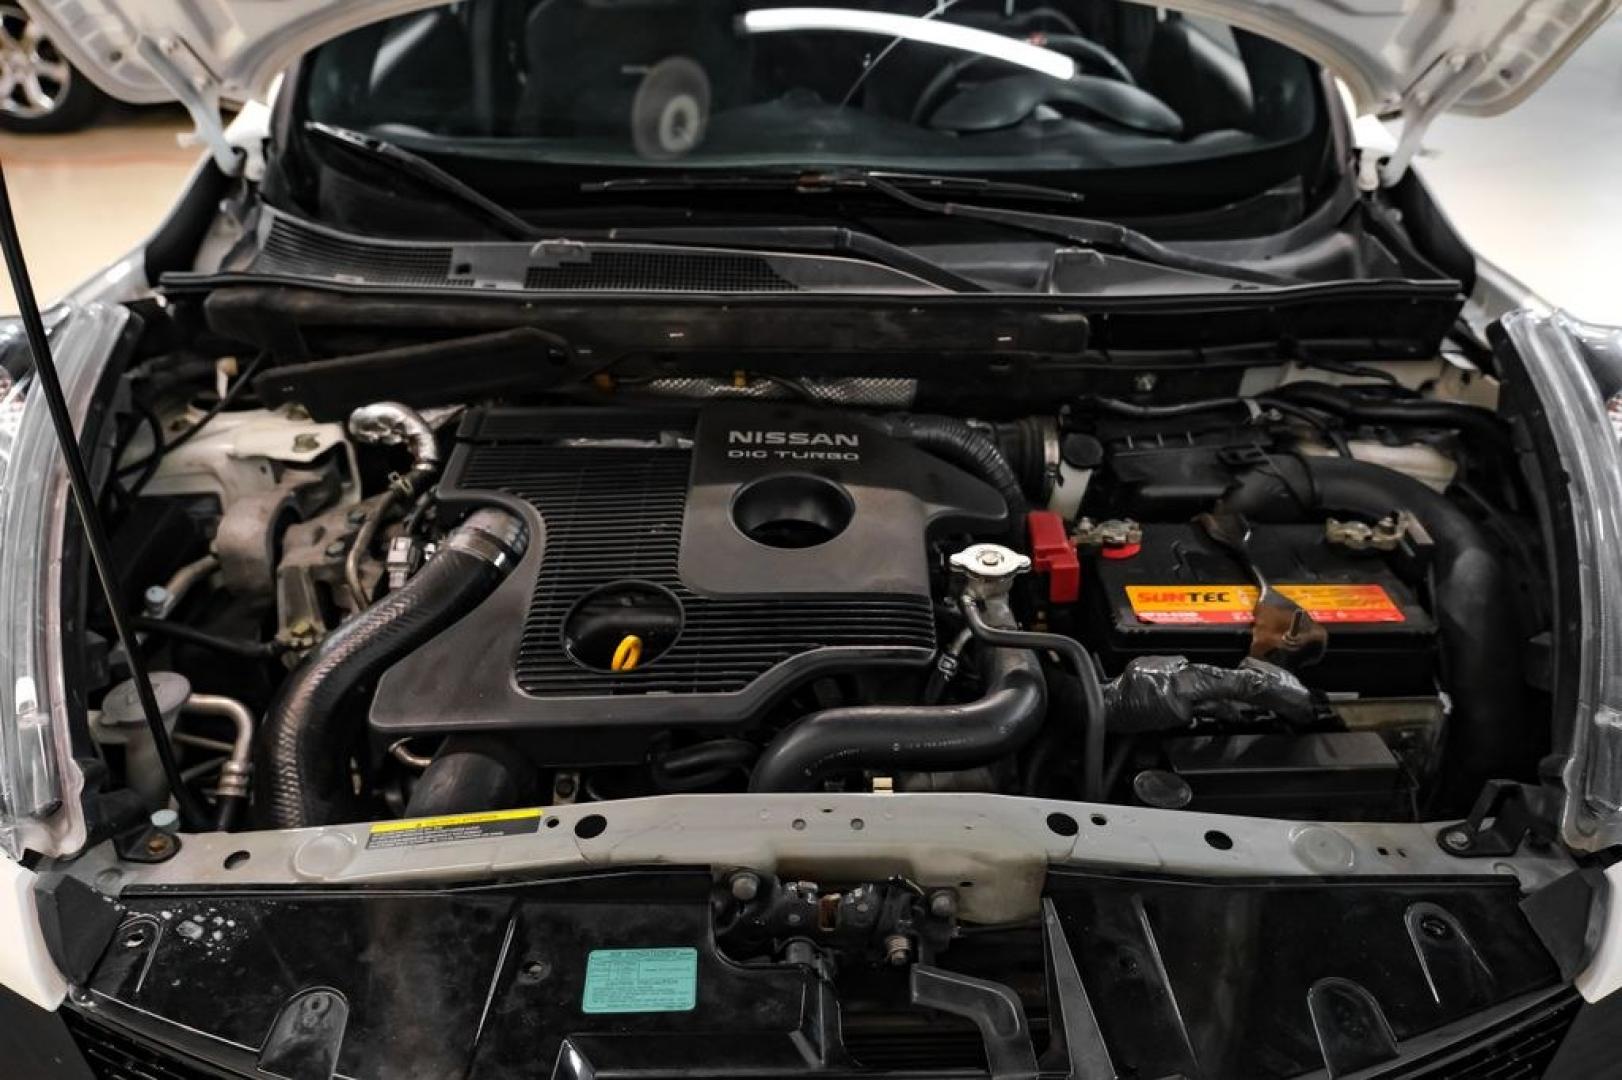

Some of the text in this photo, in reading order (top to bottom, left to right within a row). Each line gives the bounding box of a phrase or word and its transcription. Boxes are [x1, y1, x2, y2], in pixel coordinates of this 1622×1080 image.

[728, 430, 859, 446] NISSAN
[774, 451, 860, 461] TURBO
[1137, 592, 1230, 603] SUNTEC
